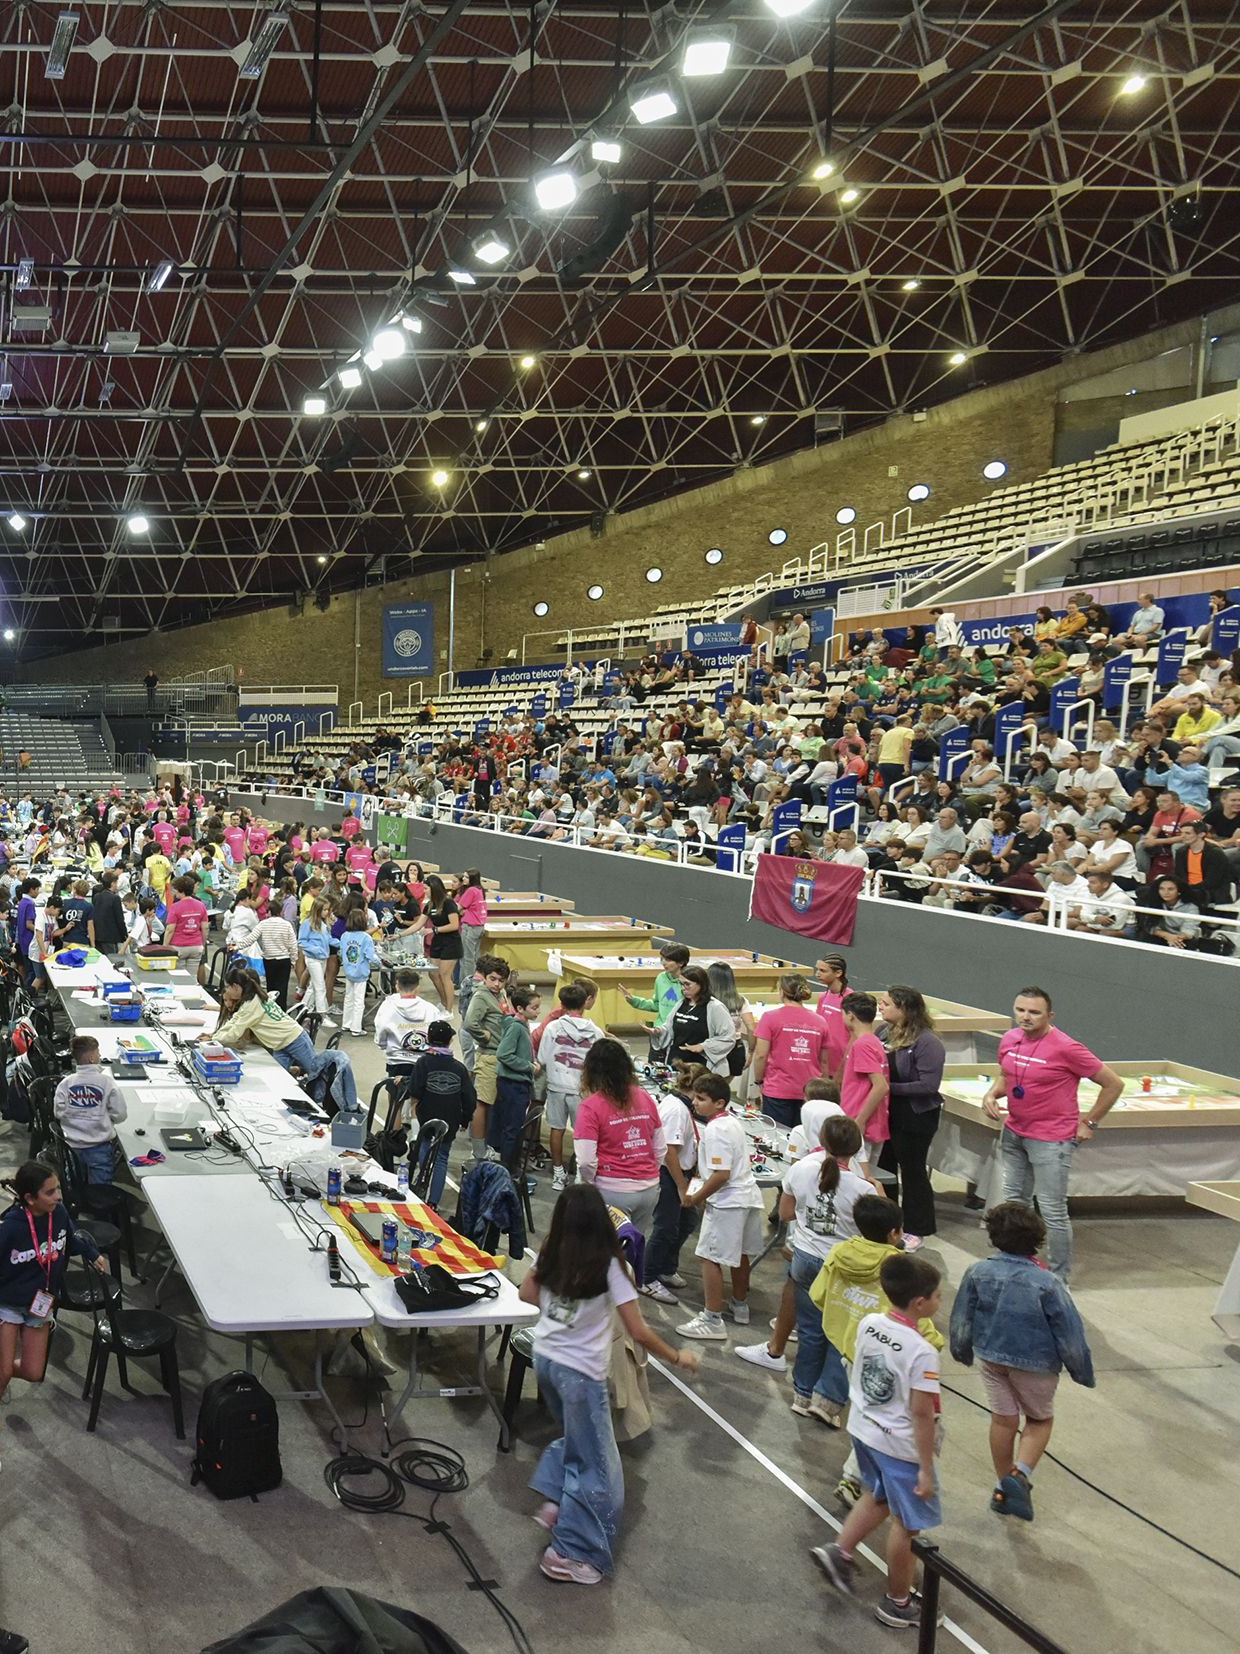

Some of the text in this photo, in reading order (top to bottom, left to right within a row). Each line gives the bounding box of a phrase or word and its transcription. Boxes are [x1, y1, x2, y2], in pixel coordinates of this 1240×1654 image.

[800, 587, 826, 597] Andorra
[500, 671, 531, 683] andorra
[864, 1325, 903, 1353] PABLO
